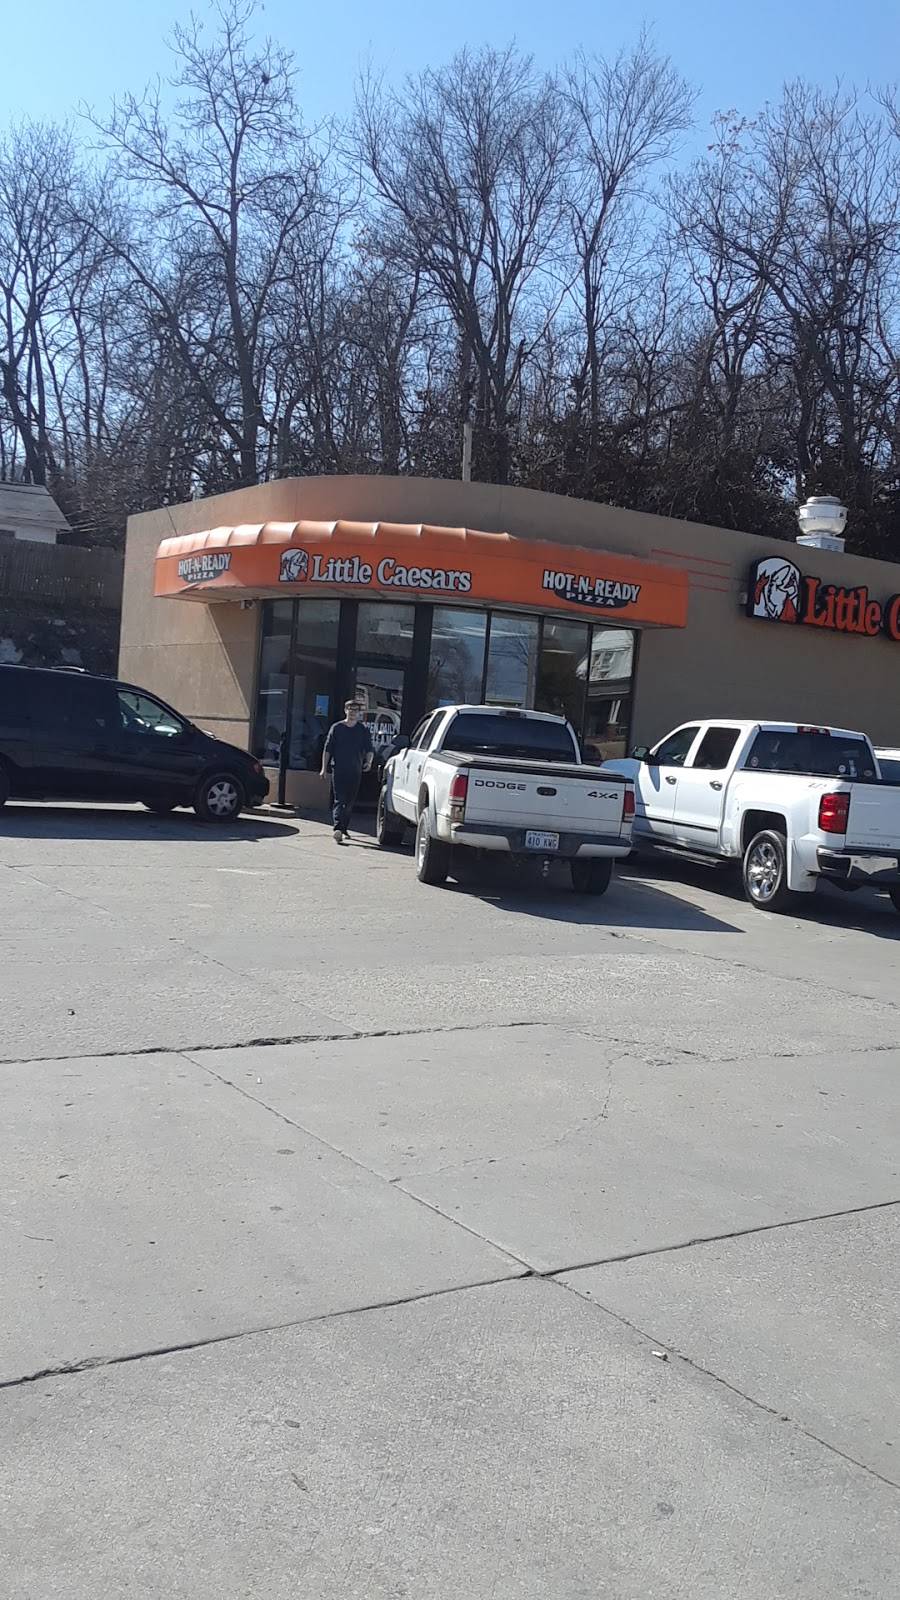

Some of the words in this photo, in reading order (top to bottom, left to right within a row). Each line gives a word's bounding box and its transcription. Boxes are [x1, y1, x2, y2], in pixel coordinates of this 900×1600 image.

[178, 553, 232, 576] HOT-N-READY
[187, 571, 215, 580] PIZZA
[310, 555, 372, 584] Little
[377, 558, 472, 592] Caesars
[542, 569, 641, 604] HOT-N-READY
[565, 591, 616, 606] PIZZA
[803, 576, 882, 636] Little
[474, 779, 527, 791] DODGE
